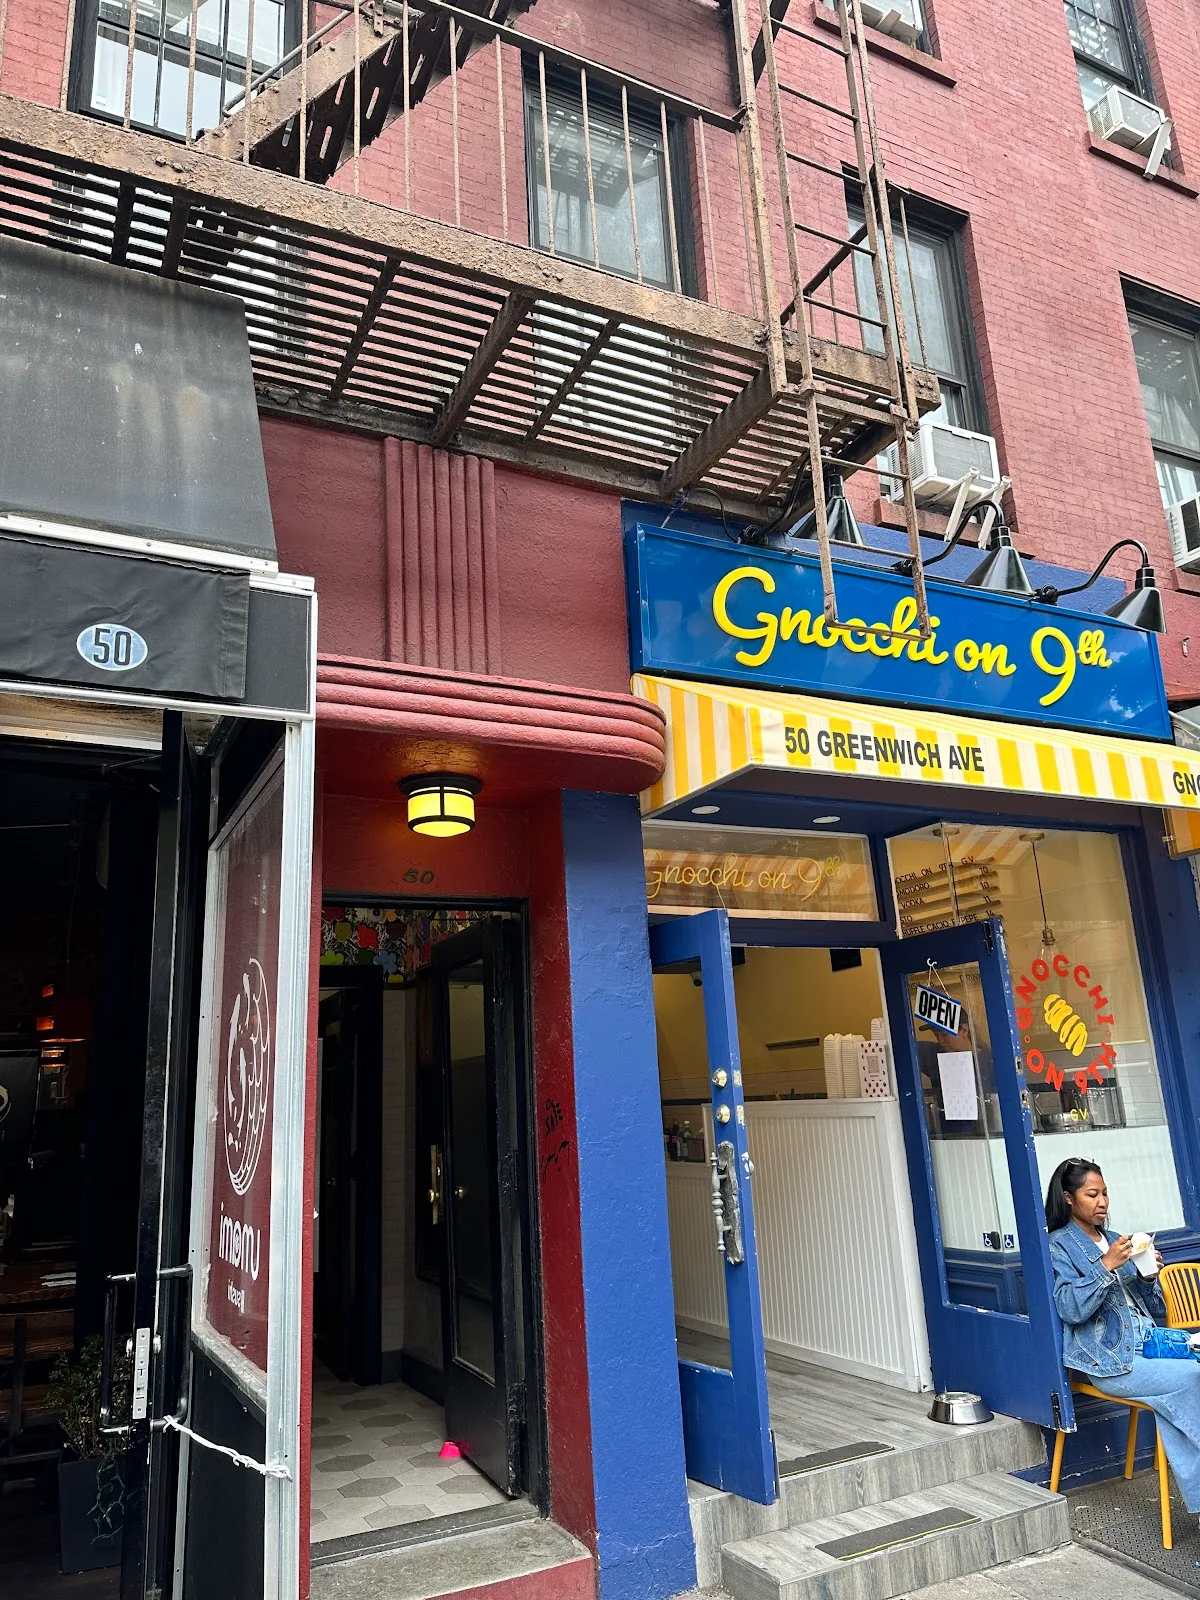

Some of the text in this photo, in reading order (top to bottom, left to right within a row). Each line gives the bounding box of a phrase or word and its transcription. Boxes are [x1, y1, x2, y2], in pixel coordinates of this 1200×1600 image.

[94, 627, 132, 667] 50
[712, 565, 1112, 707] Gnocchi on 9th
[784, 727, 985, 772] 50 GREENWICH AVE
[402, 868, 435, 884] 50
[758, 870, 792, 890] on
[797, 857, 845, 902] 9th
[921, 868, 933, 876] ON
[979, 866, 989, 875] 10
[900, 881, 990, 909] VODKA 10
[983, 895, 992, 904] 11
[926, 920, 949, 932] CACIO
[960, 914, 978, 924] PEPE
[1015, 954, 1115, 1030] GNOCCHI
[918, 990, 957, 1030] OPEN
[1026, 1042, 1118, 1095] ON 9TH
[1070, 1108, 1087, 1121] GV
